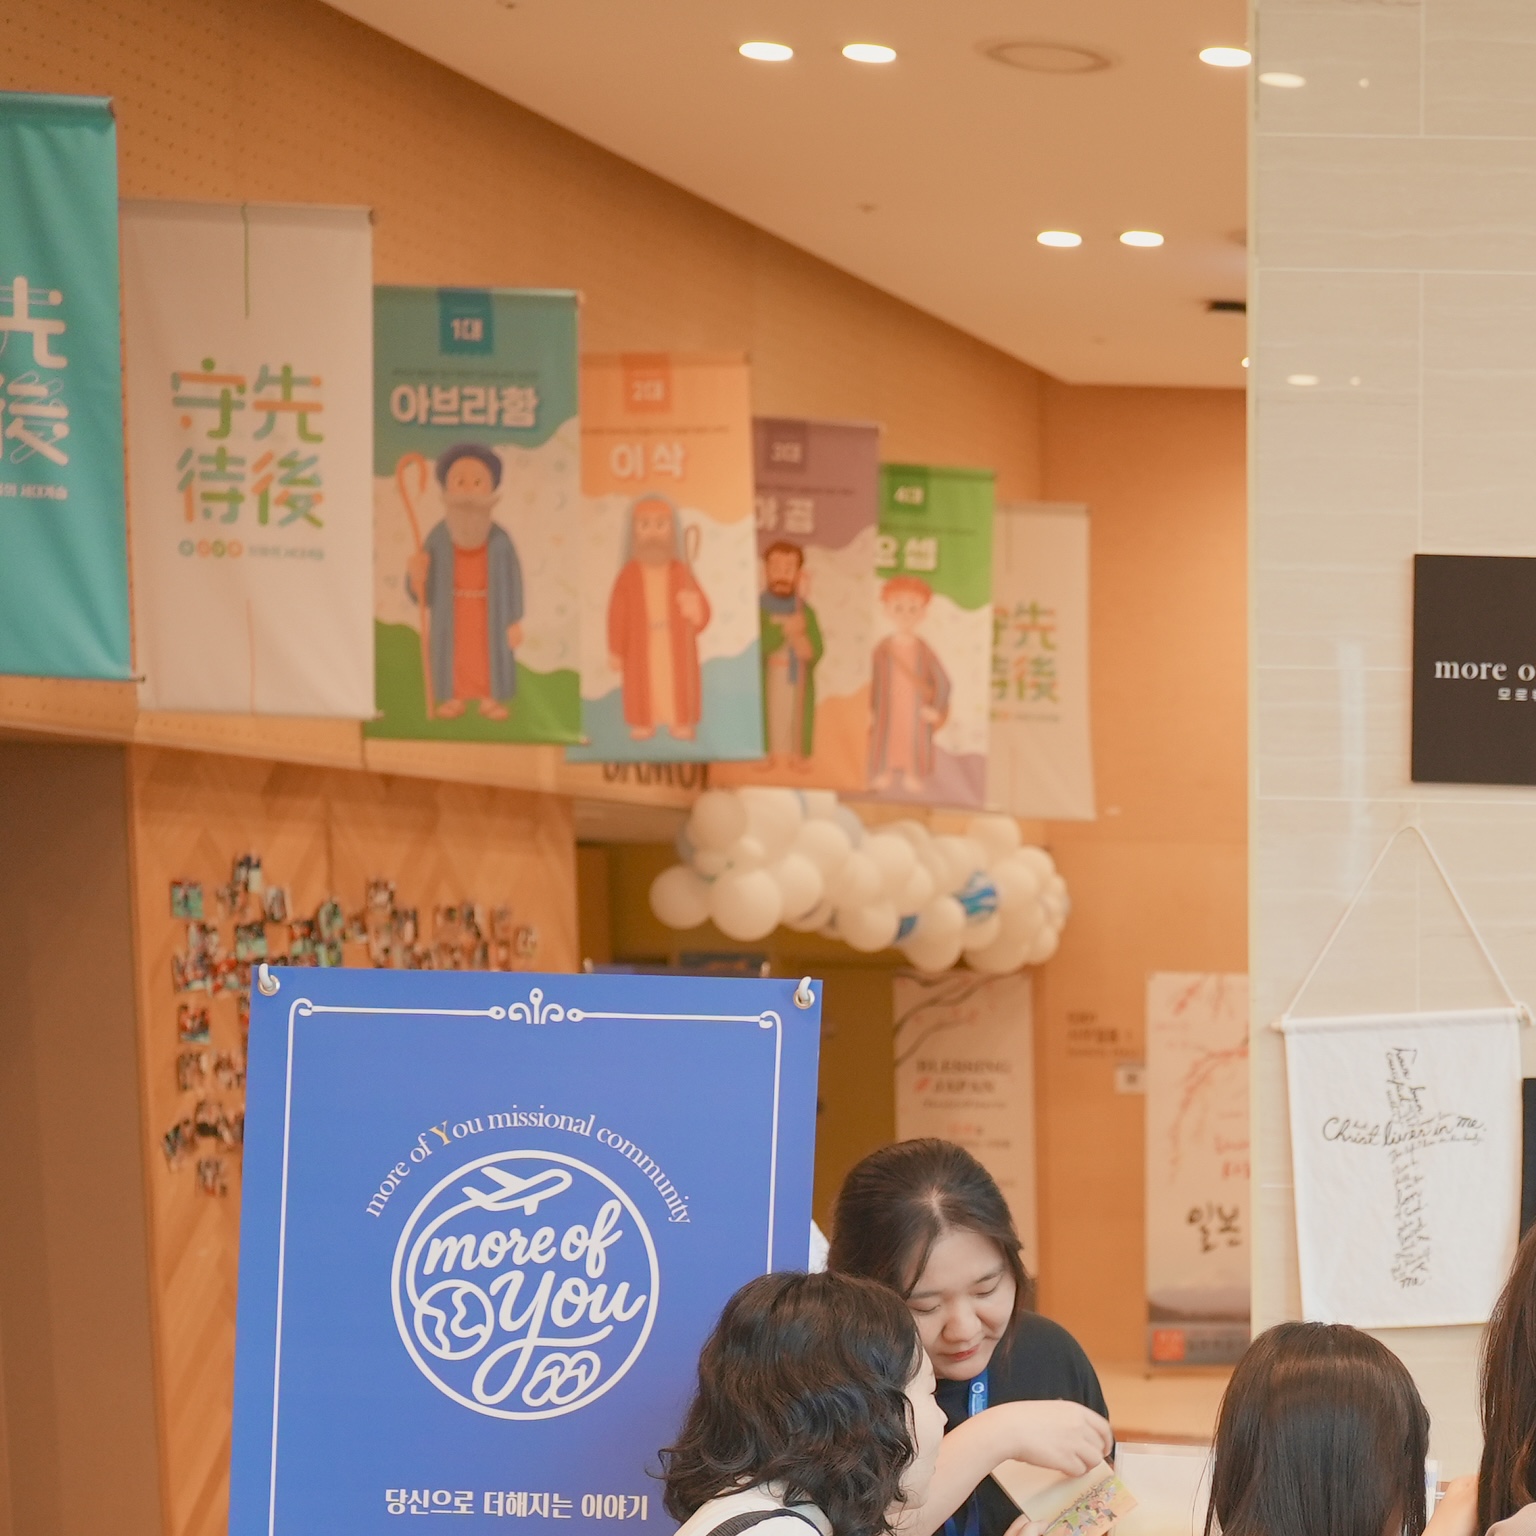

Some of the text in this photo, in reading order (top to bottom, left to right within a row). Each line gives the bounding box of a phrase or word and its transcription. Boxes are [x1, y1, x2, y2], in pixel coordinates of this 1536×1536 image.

[451, 318, 483, 342] 1대
[389, 383, 540, 428] 아브라함
[1434, 658, 1507, 681] more
[1322, 1117, 1380, 1146] Christ
[365, 1103, 692, 1225] more of You missional community
[422, 1198, 625, 1278] more of
[472, 1269, 648, 1405] You
[385, 1488, 649, 1521] 당신으로 더해지는 이야기
